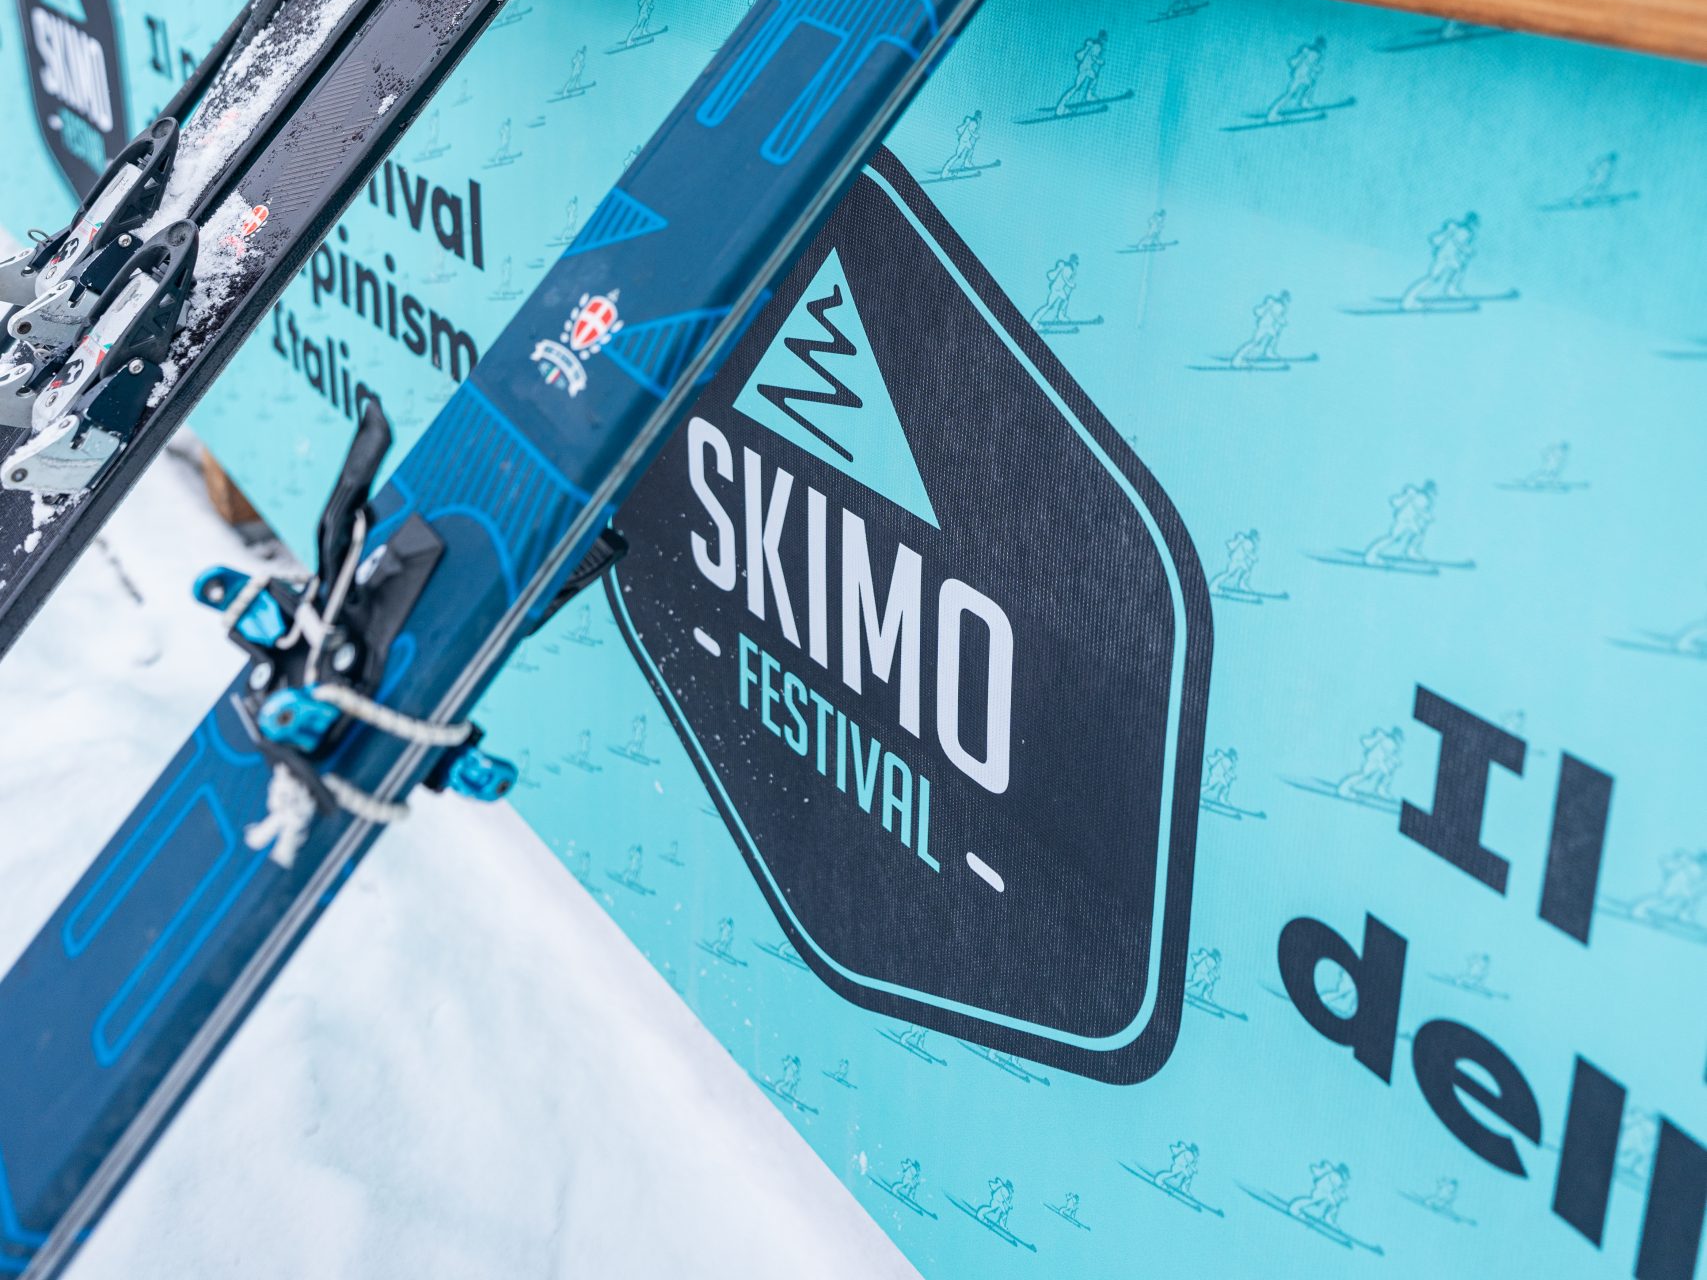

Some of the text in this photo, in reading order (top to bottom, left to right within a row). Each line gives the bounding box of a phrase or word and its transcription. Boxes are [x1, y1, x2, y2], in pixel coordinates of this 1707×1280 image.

[688, 416, 1015, 795] SKIMO
[738, 632, 941, 874] FESTIVAL
[1398, 682, 1615, 948] Il
